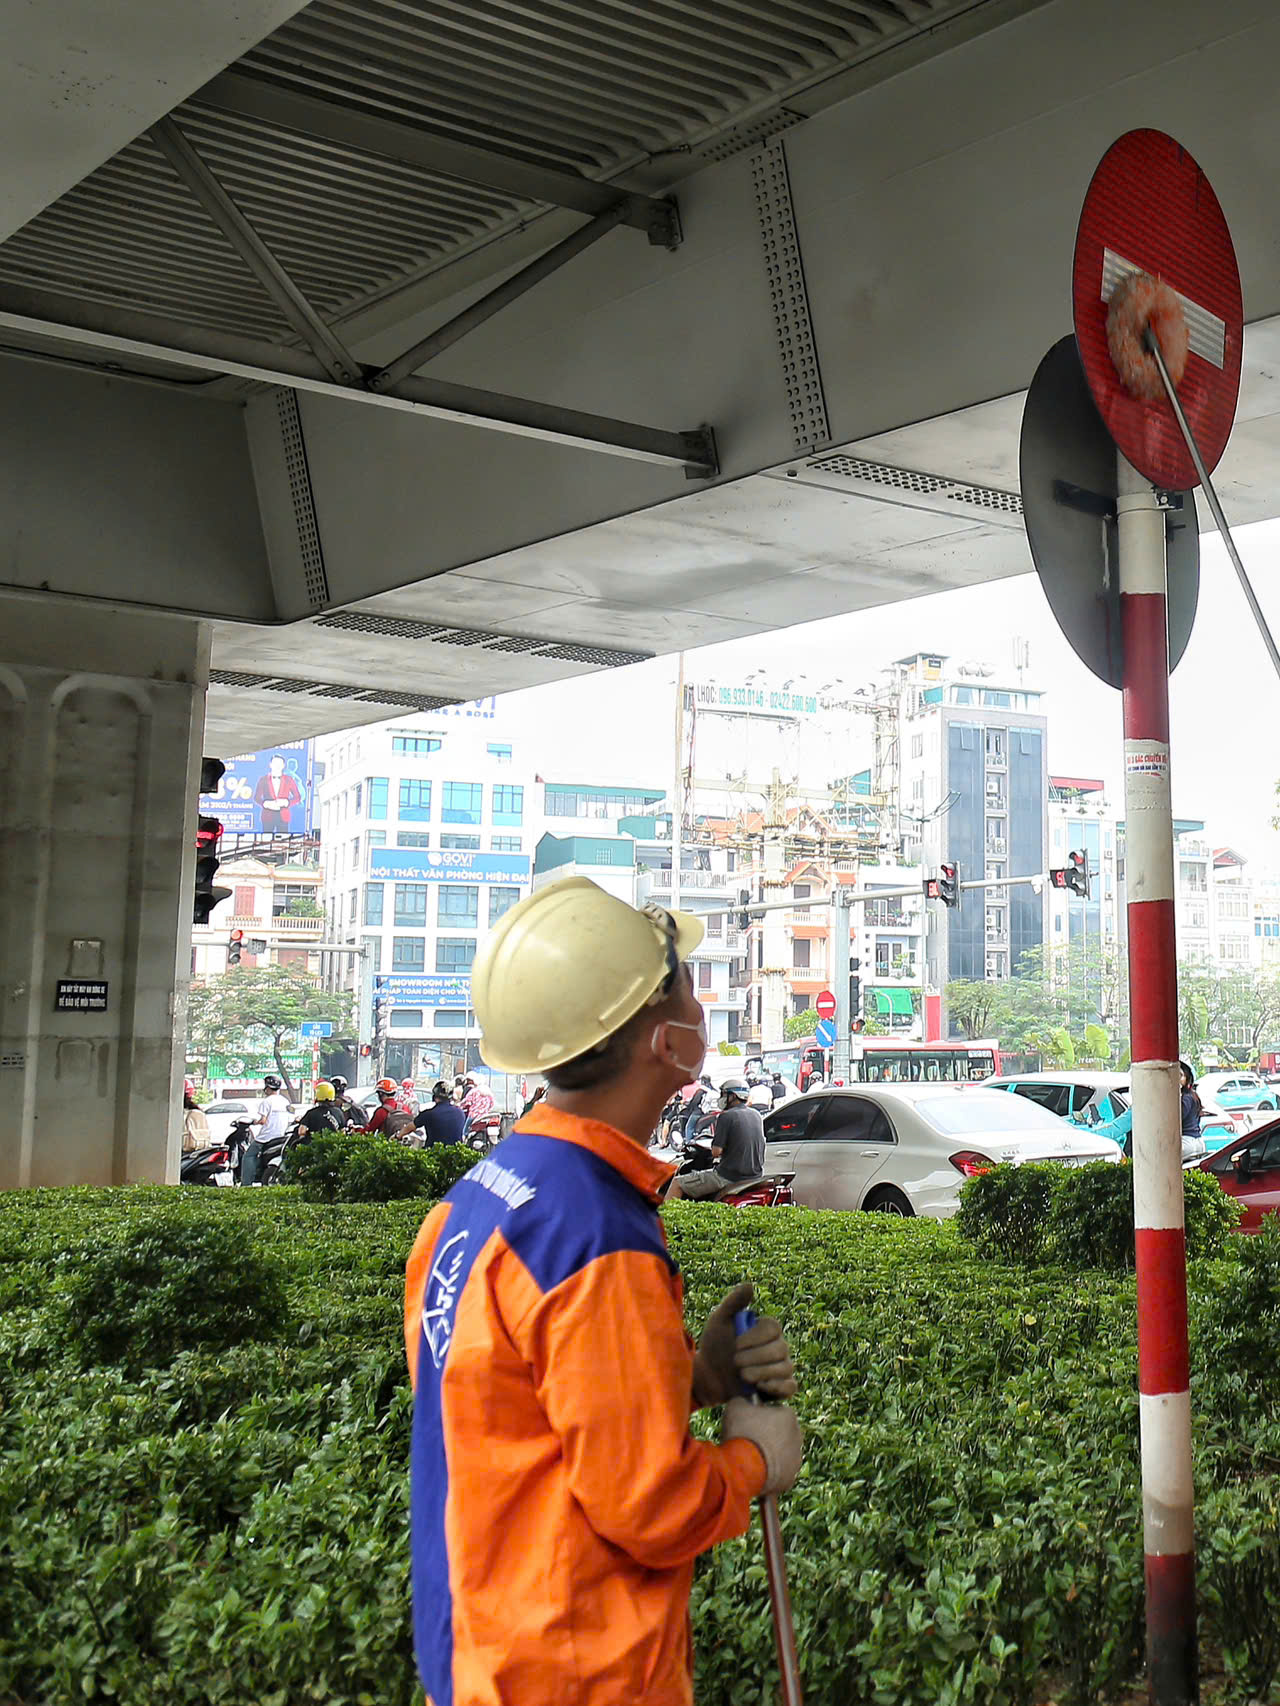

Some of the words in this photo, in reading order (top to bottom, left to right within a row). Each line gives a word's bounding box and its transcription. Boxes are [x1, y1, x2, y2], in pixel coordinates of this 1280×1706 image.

[443, 853, 473, 864] GOVI
[371, 866, 391, 878] NỘI
[392, 866, 420, 879] THẤT
[421, 867, 445, 880] VĂN
[446, 868, 483, 881] PHÒNG
[388, 978, 443, 987] SHOWROOM
